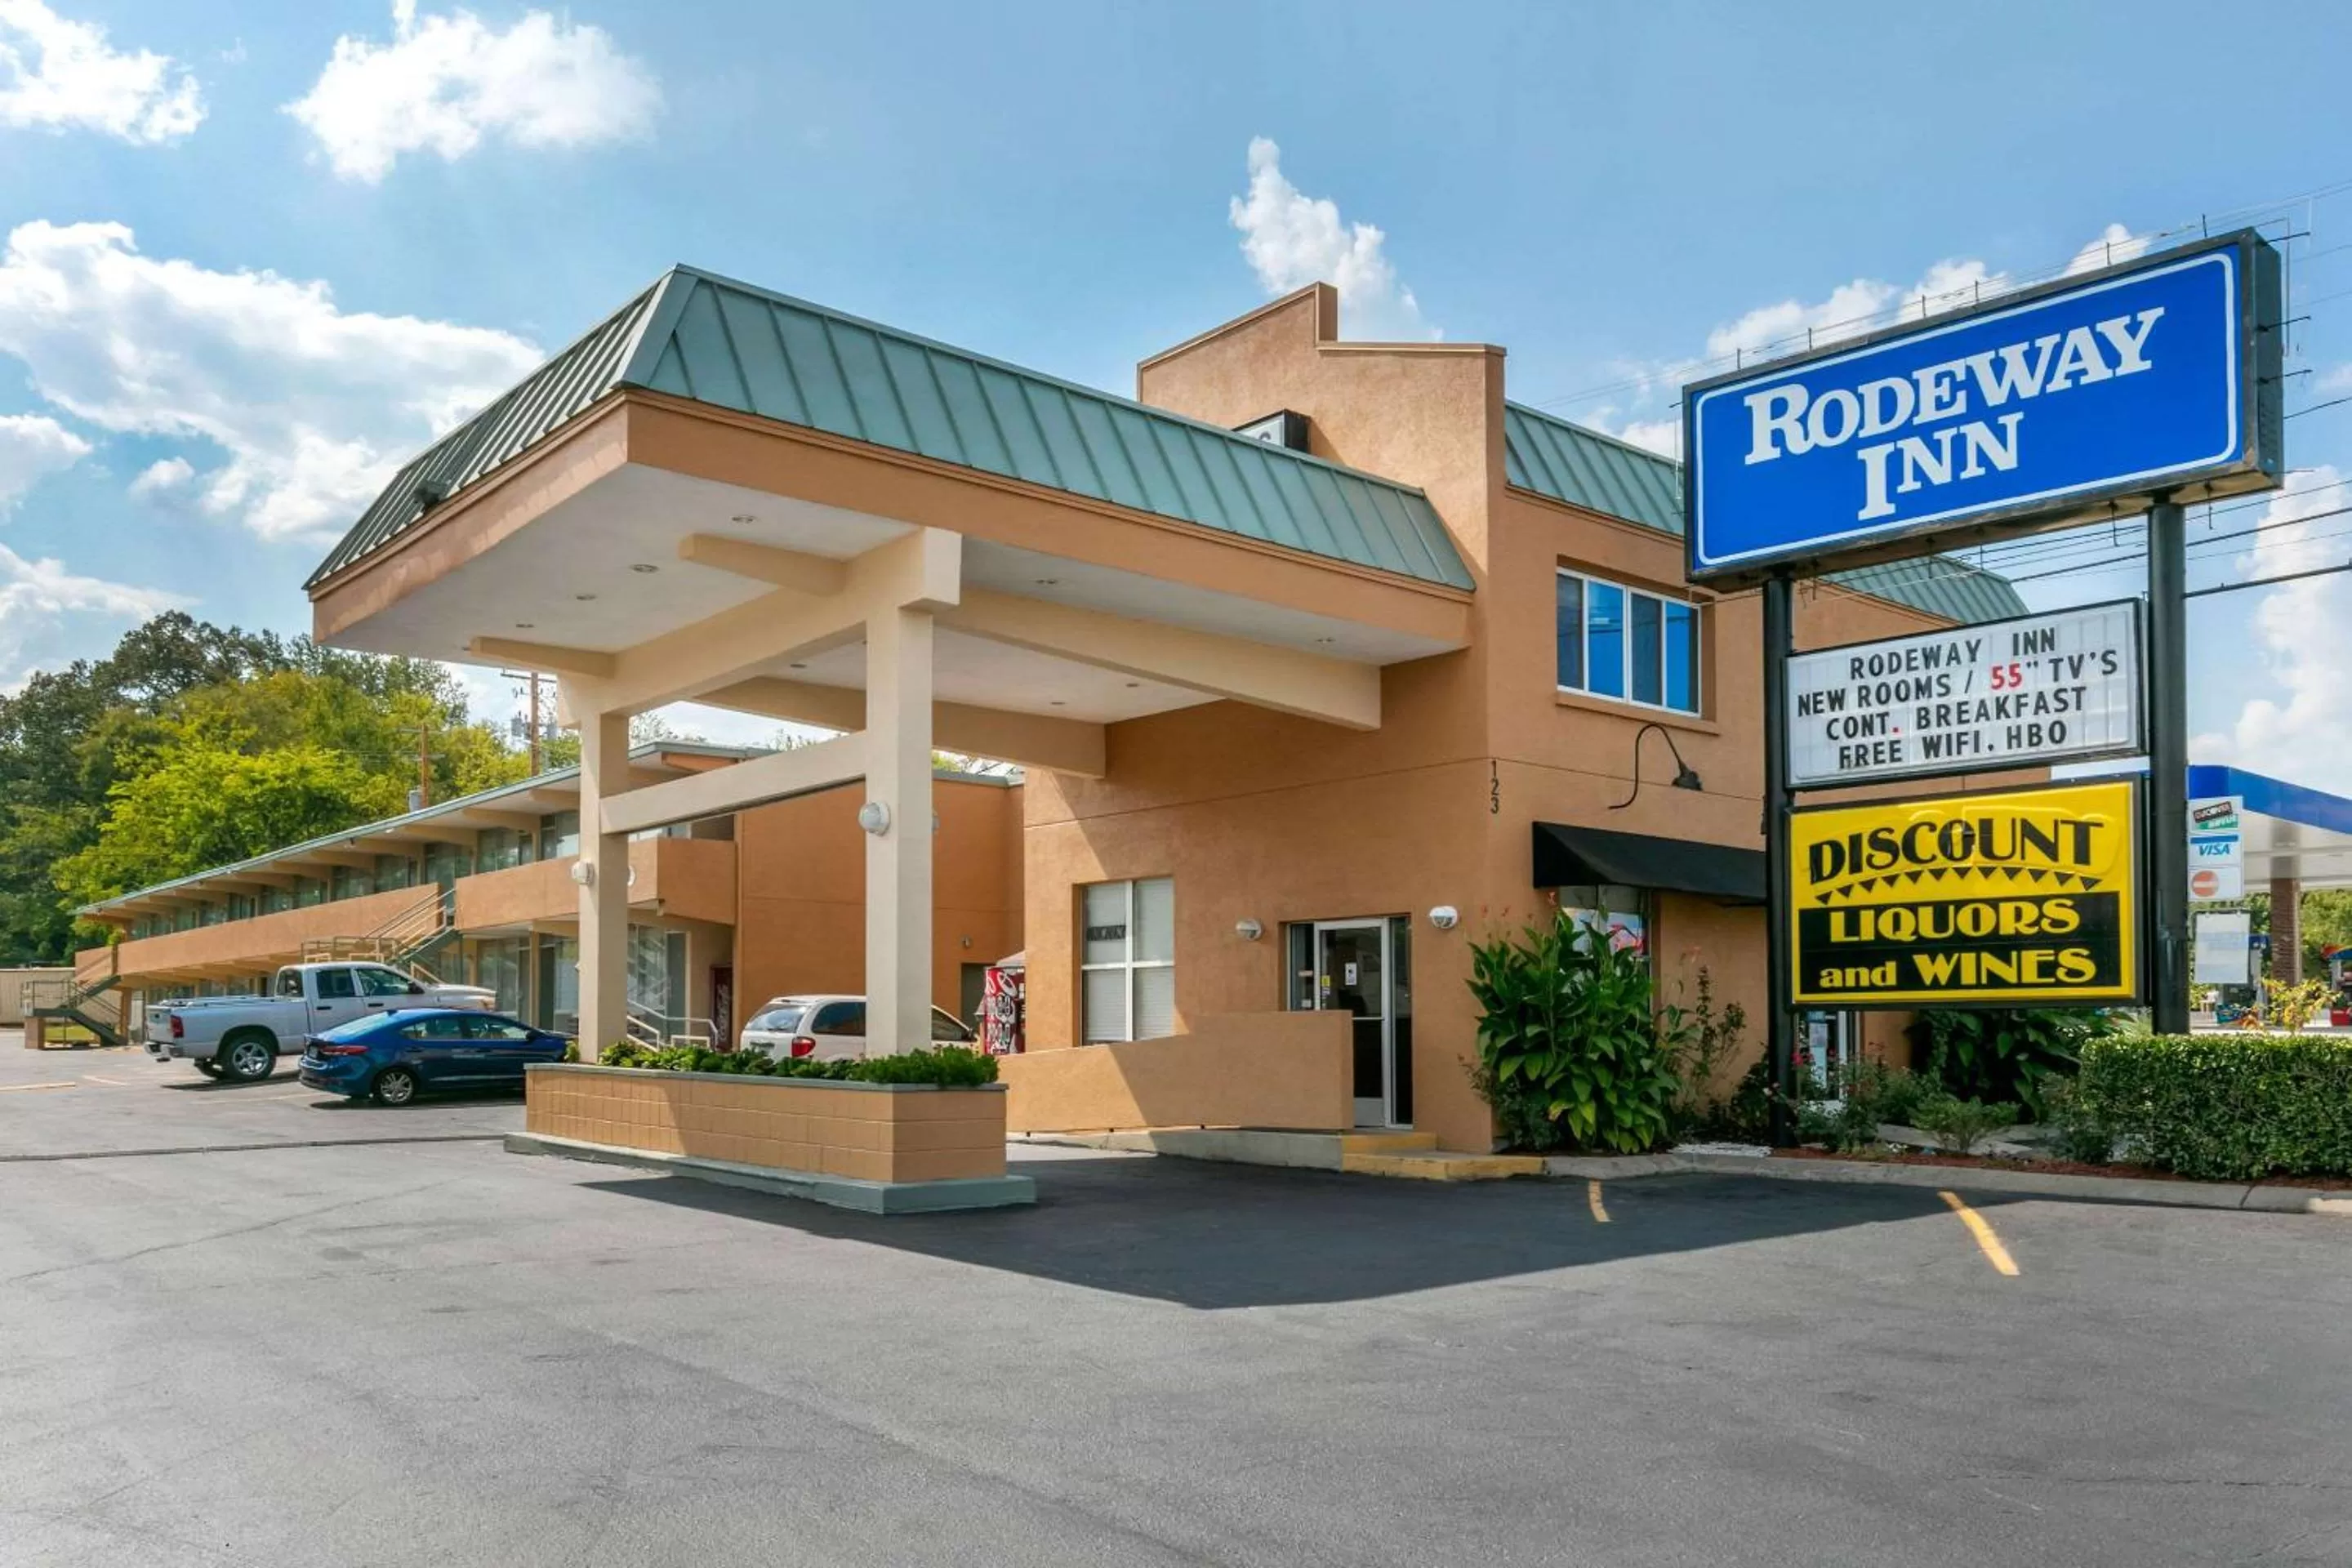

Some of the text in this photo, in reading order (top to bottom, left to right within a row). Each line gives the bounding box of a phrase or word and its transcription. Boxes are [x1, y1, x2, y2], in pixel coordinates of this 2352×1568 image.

[1744, 306, 2165, 466] RODEWAY
[1857, 411, 2024, 521] INN
[1851, 627, 2056, 680] RODEWAY INN
[1797, 688, 1846, 717] NEW
[1858, 674, 1951, 709] ROOMS
[2049, 650, 2118, 684] TV'S
[1826, 686, 2087, 741] CONT. BREAKFAST
[1838, 740, 1903, 769] FREE
[2007, 720, 2067, 750] HBO
[1809, 817, 2105, 884] DISCOUNT
[2198, 844, 2230, 856] VISA
[1829, 898, 2080, 942] LIQUORS
[1820, 947, 2096, 989] and WINES
